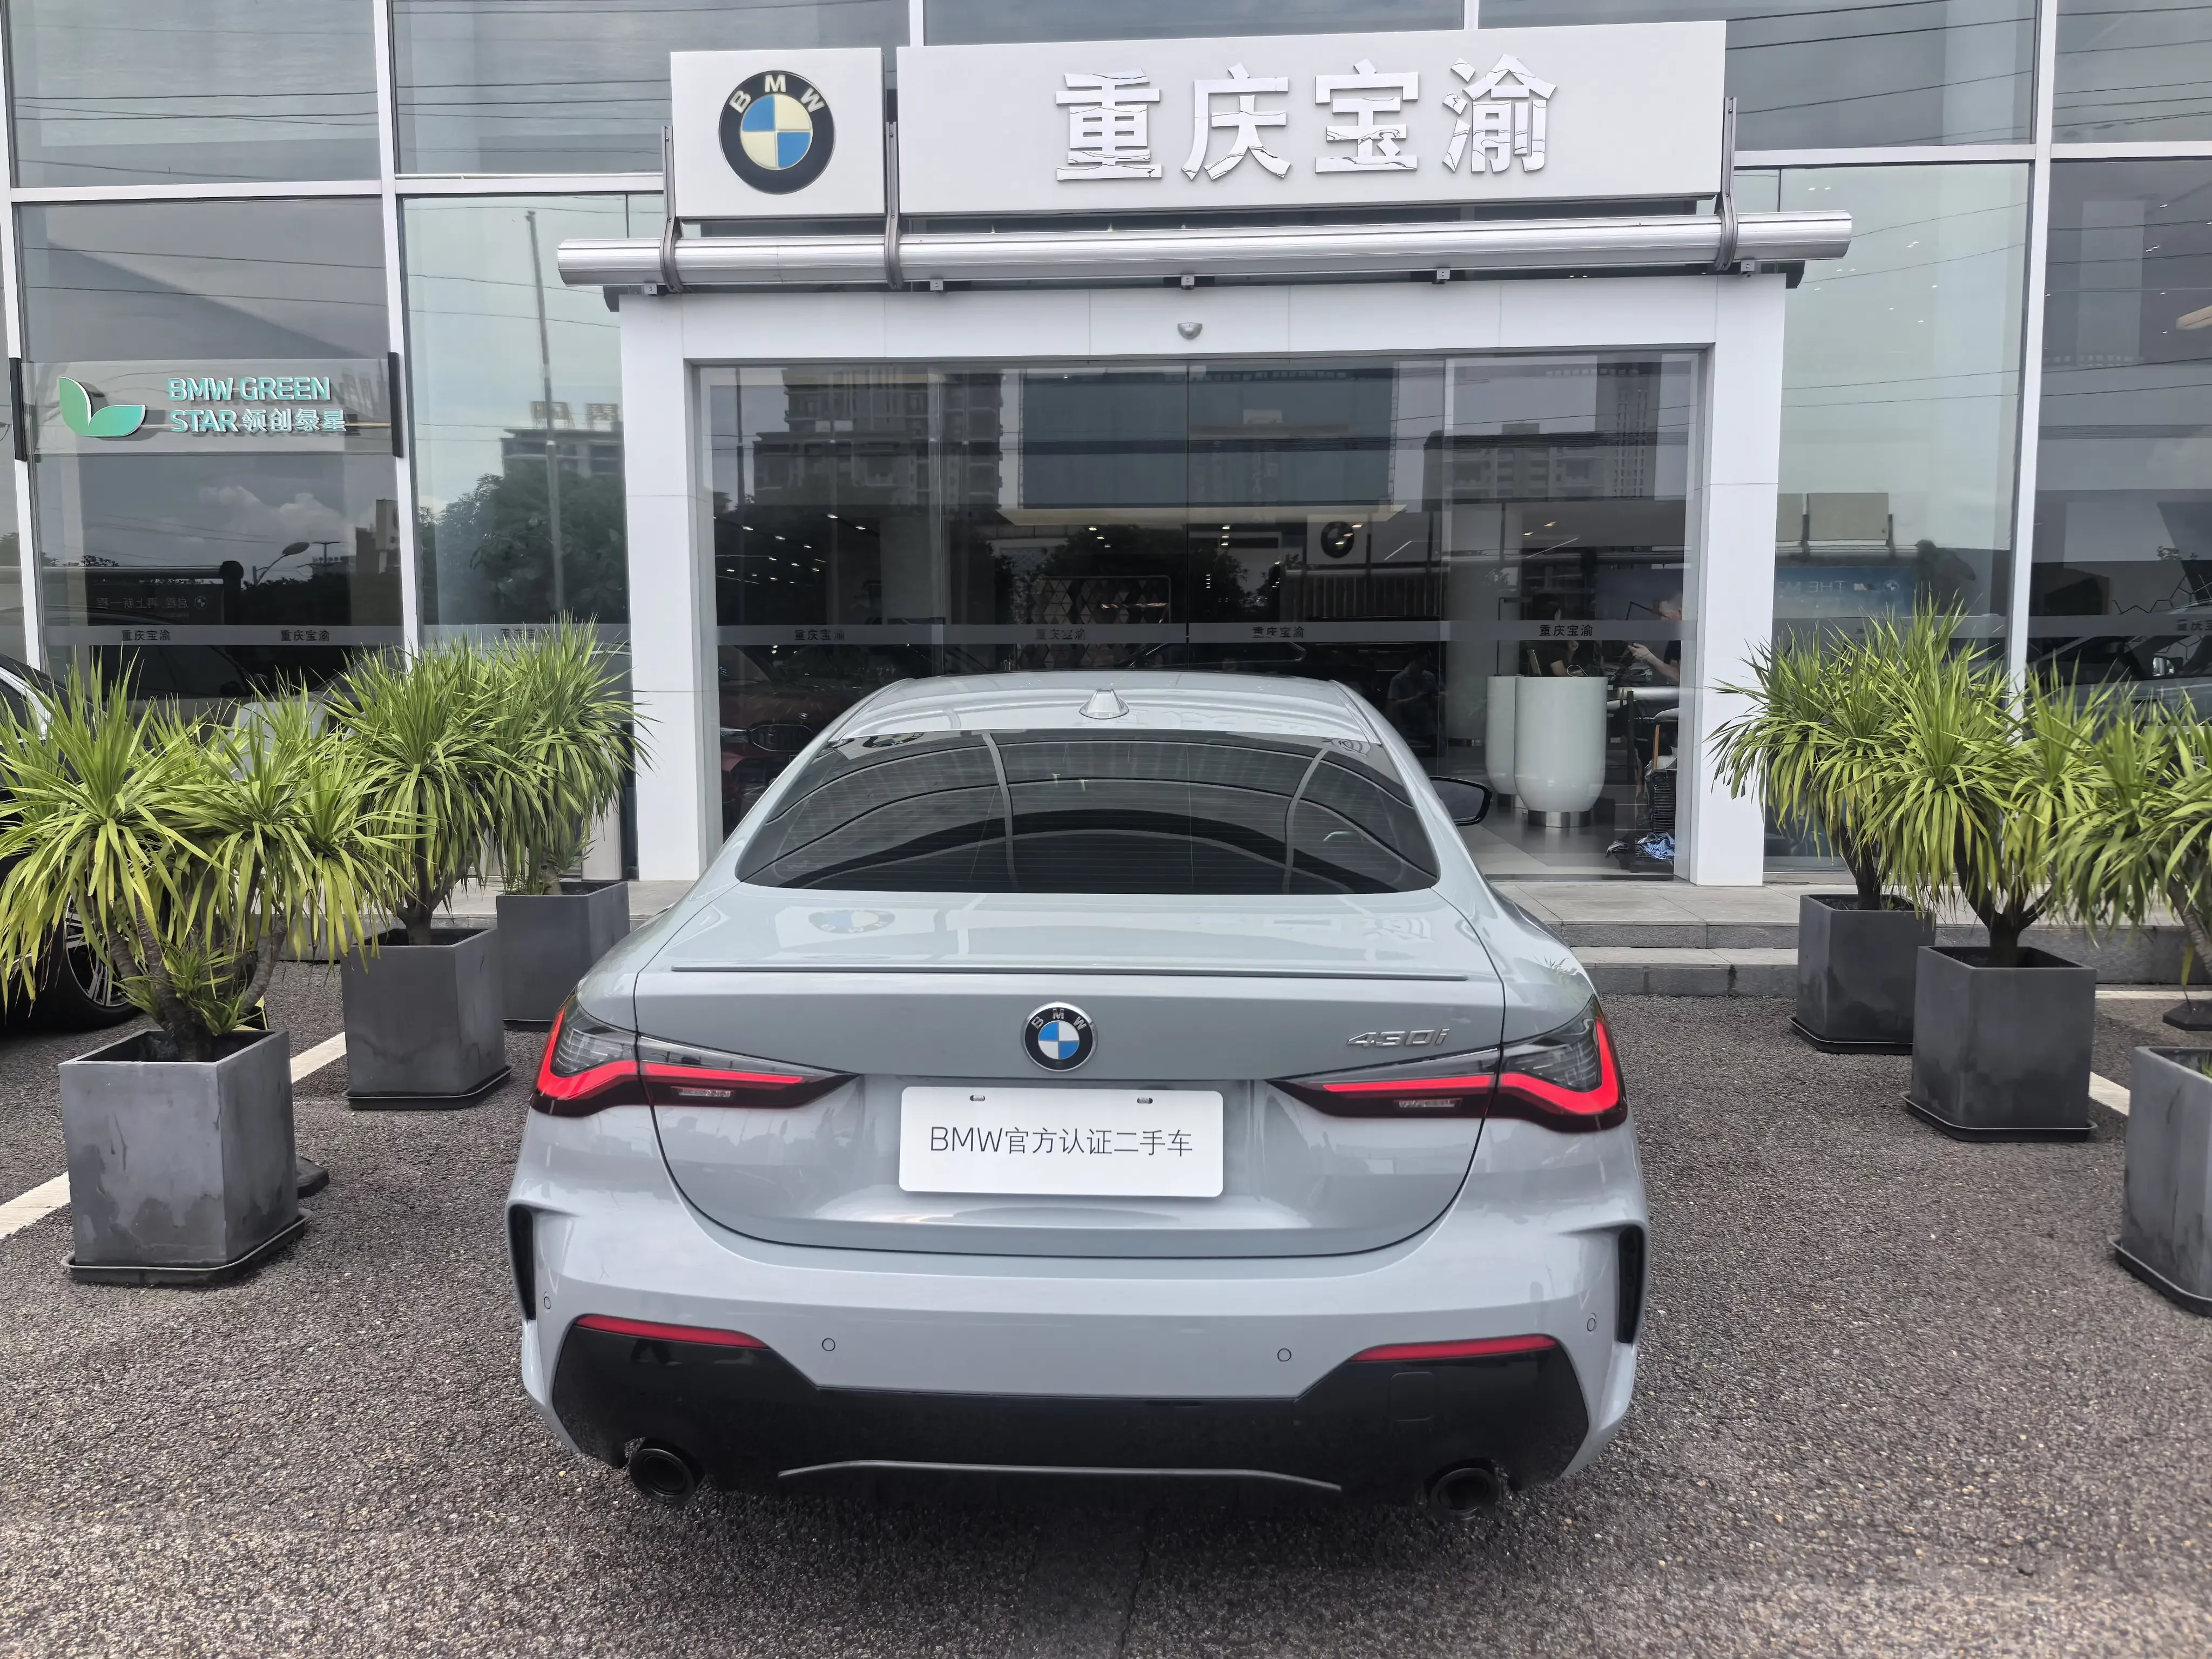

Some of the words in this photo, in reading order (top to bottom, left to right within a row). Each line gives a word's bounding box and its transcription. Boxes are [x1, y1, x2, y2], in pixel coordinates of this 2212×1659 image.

[729, 75, 825, 113] BMW
[1055, 54, 1558, 182] 重庆宝渝
[168, 377, 233, 401] BMW
[239, 377, 331, 401] GREEN
[170, 409, 238, 433] STAR
[241, 408, 346, 432] 领创绿星
[122, 629, 171, 642] 重庆宝渝
[281, 629, 330, 642] 重庆宝渝
[794, 629, 845, 642] 重庆宝渝
[1251, 626, 1305, 638] 重庆宝渝
[1539, 624, 1593, 637] 重庆宝渝
[1031, 1008, 1087, 1030] BMW
[1347, 1028, 1449, 1047] 430i
[929, 1126, 1193, 1157] BMW官方认证二手车
